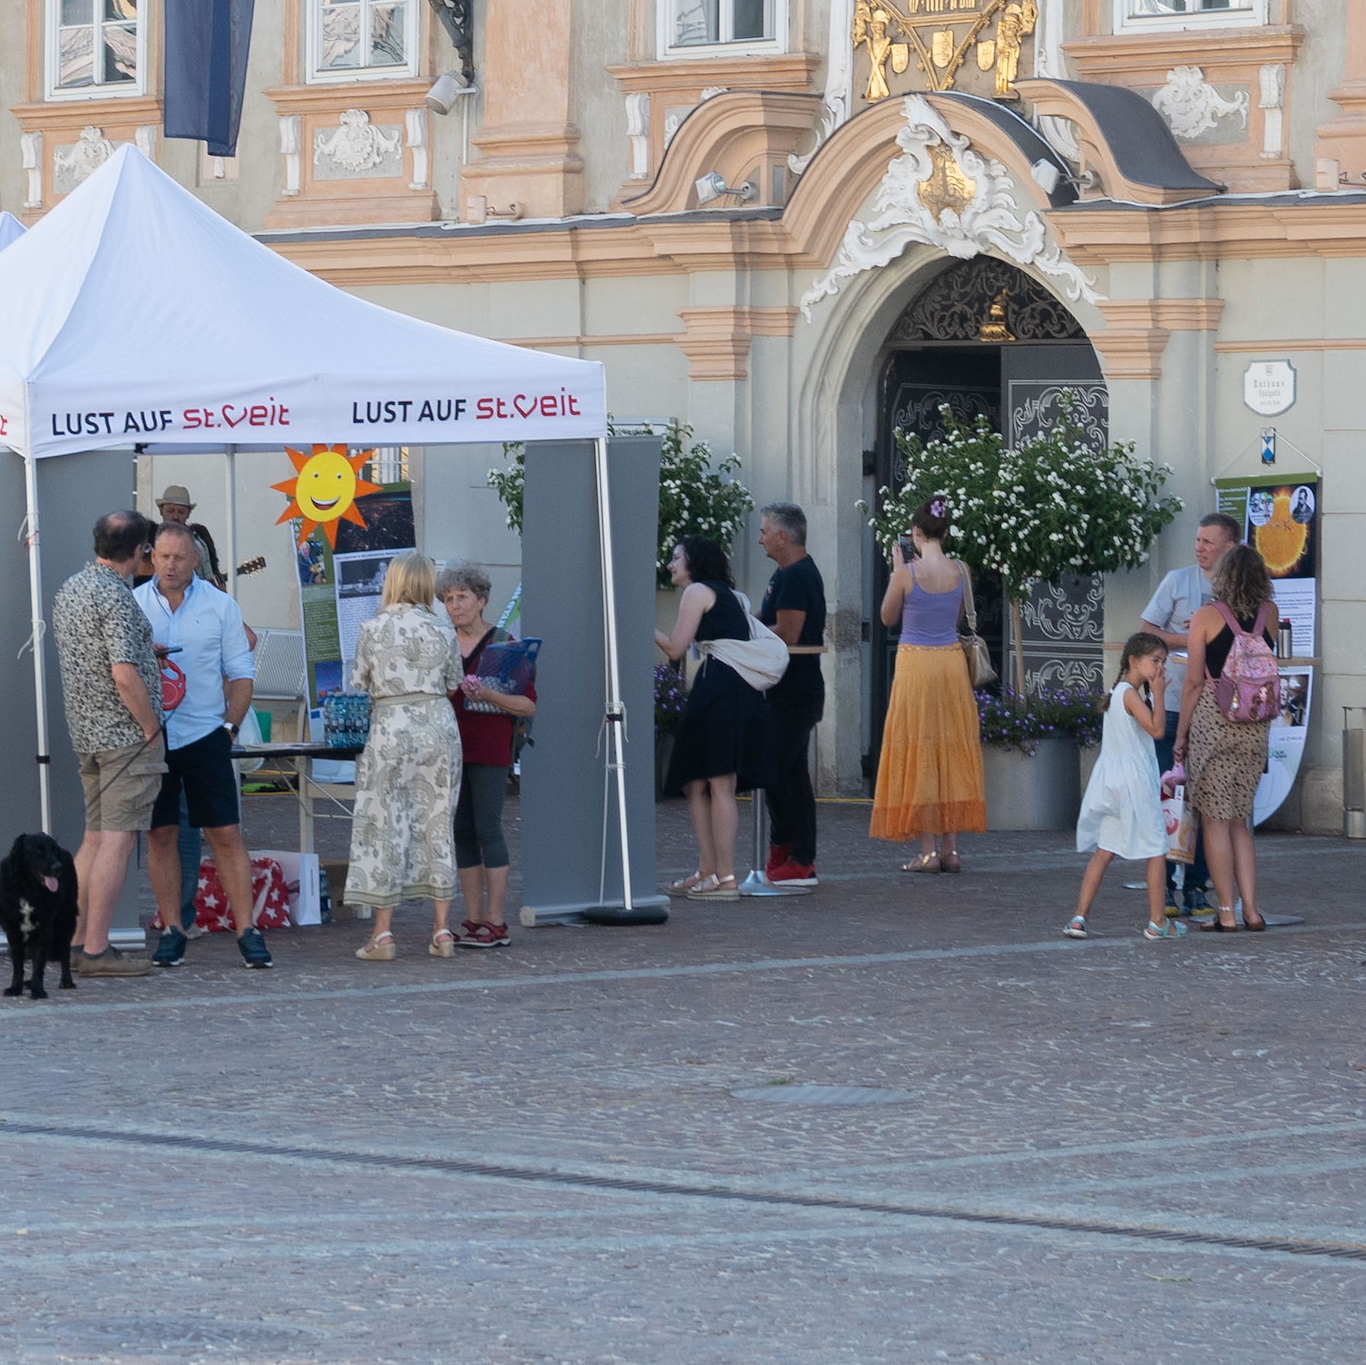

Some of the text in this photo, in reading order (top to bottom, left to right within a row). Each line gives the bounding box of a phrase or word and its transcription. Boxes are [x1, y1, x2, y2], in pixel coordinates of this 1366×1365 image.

[52, 412, 114, 435] LUST
[123, 410, 173, 433] AUF
[352, 401, 413, 424] LUST
[418, 399, 466, 422] AUF
